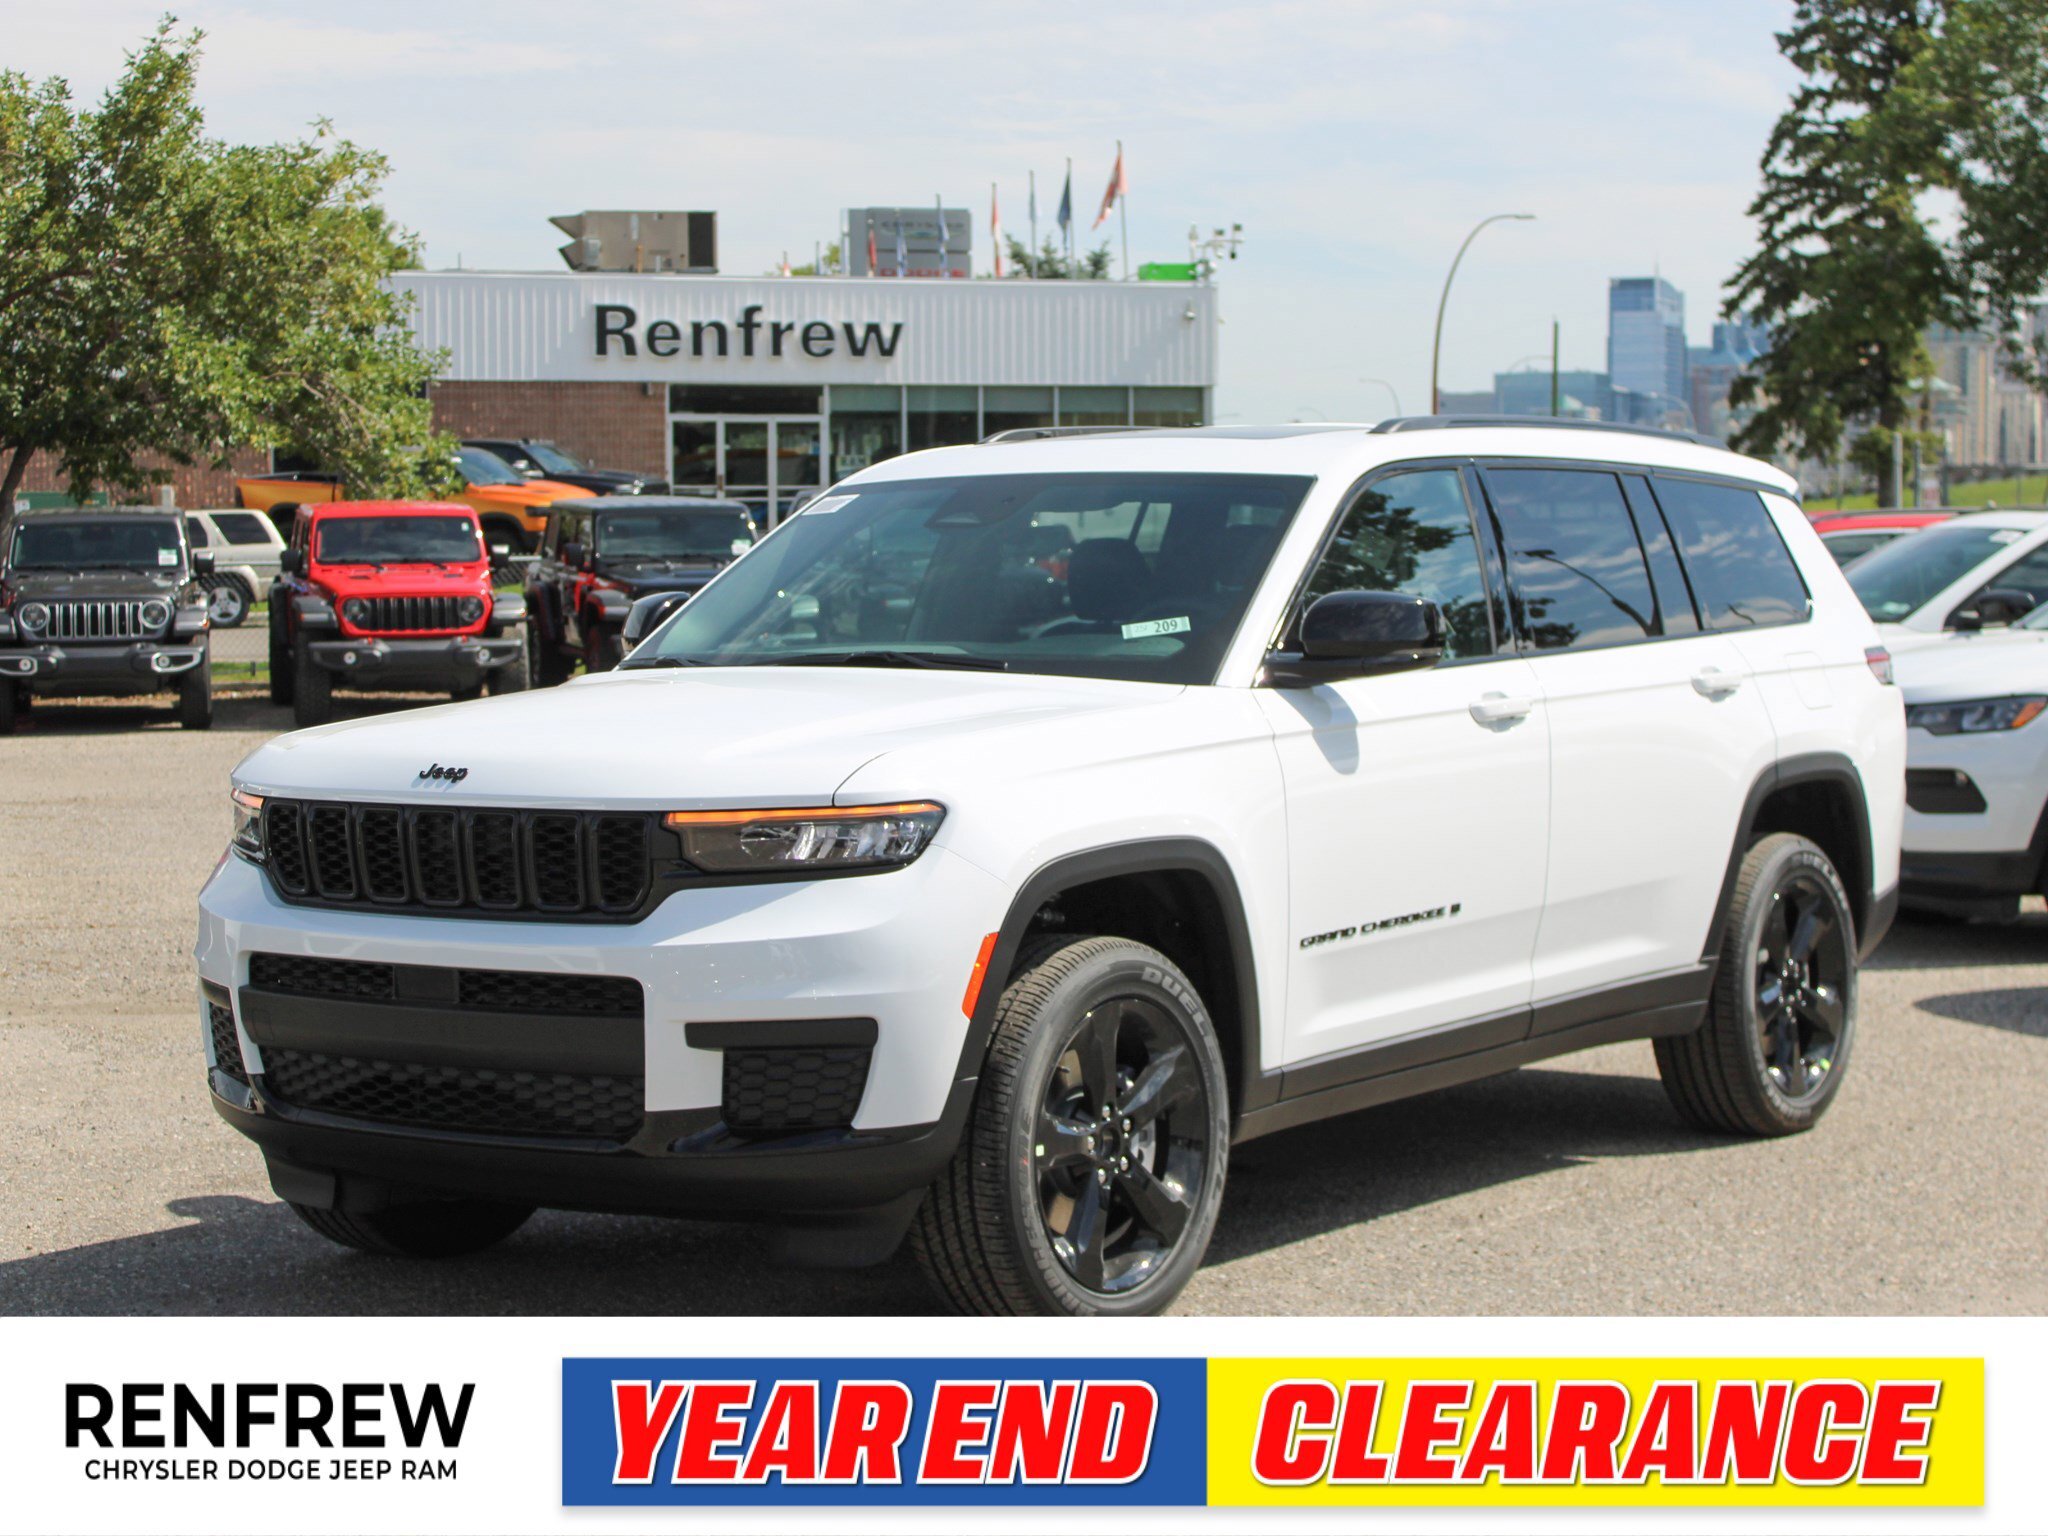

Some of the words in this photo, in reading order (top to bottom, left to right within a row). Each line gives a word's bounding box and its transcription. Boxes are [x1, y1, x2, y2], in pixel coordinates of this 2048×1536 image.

[594, 305, 904, 358] Renfrew
[1153, 619, 1178, 634] 209
[419, 763, 468, 783] Jeep
[1300, 927, 1356, 949] GRAND
[1361, 906, 1446, 934] CHEROKEE
